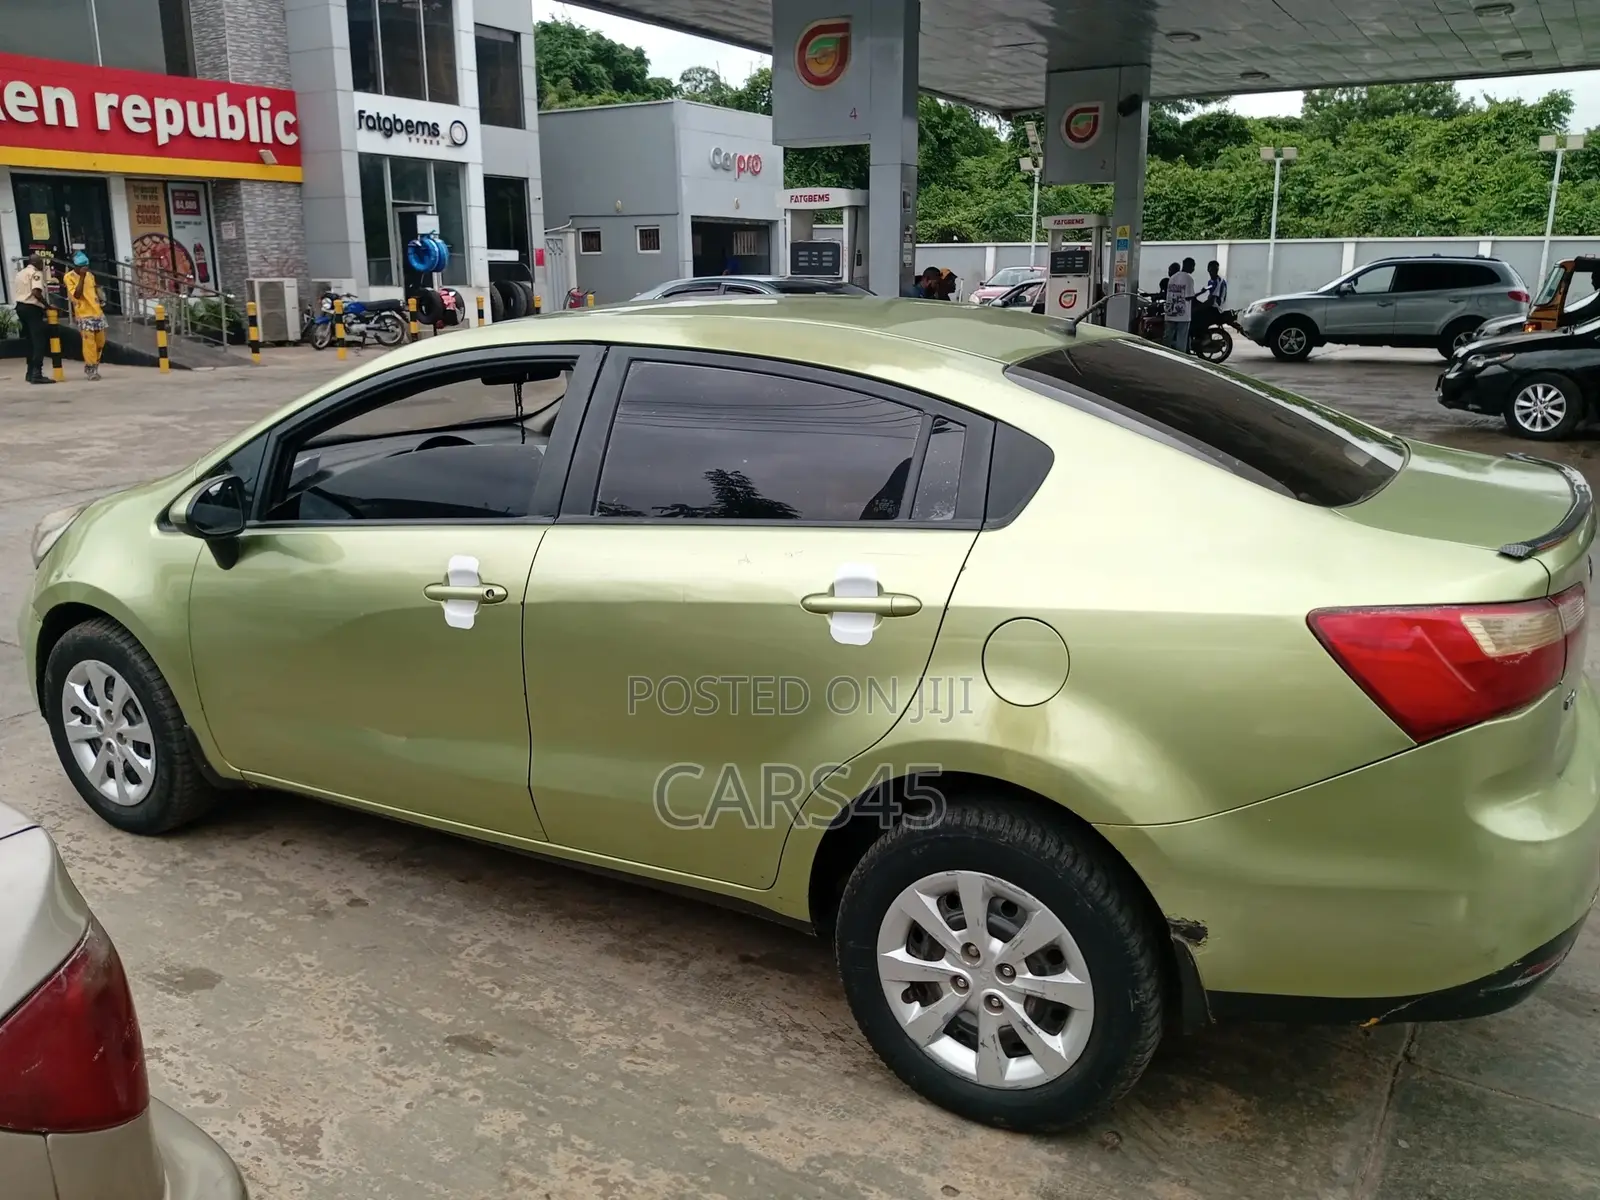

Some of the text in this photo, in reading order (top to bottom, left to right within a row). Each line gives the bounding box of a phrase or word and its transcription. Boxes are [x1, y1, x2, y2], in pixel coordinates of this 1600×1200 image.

[0, 80, 299, 146] en republic
[849, 107, 858, 120] 4
[357, 110, 441, 138] Fatgbems
[789, 193, 830, 204] FATGBEMS
[1053, 218, 1085, 226] FATGBEMS
